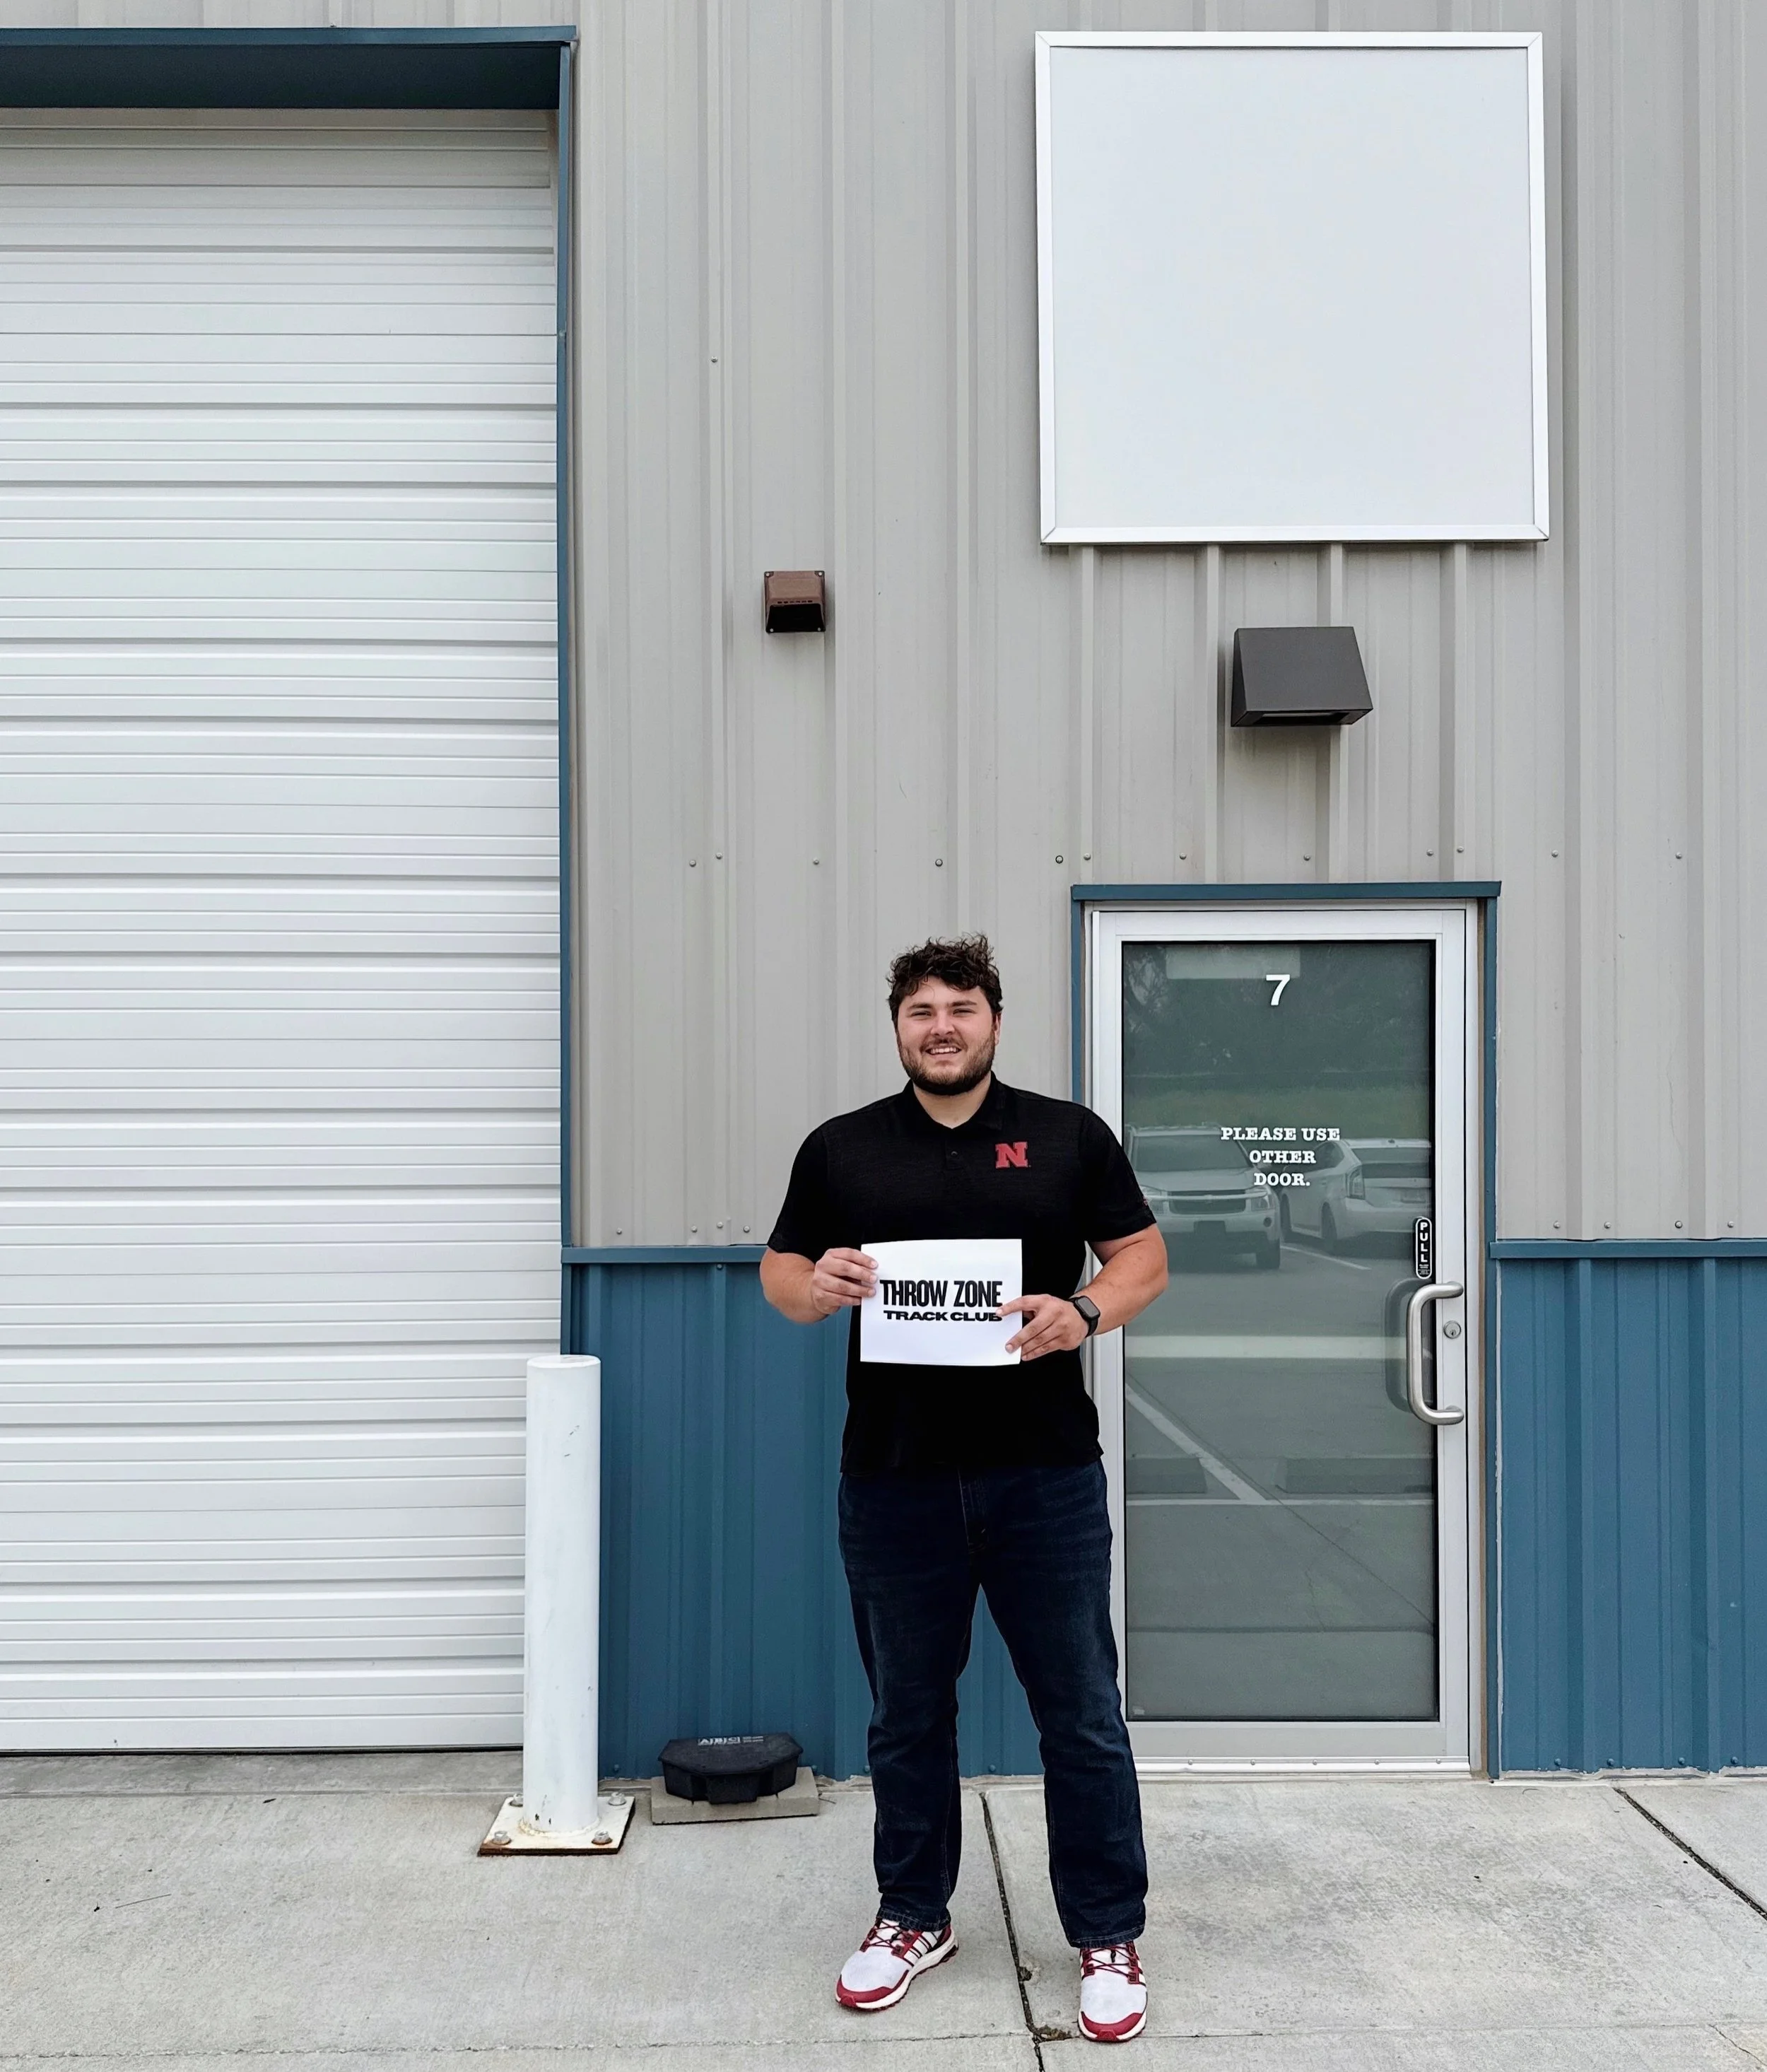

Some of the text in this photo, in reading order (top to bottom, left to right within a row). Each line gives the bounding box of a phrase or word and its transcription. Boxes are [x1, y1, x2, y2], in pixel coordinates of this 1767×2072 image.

[1266, 974, 1291, 1005] 7
[1221, 1127, 1340, 1141] PLEASE USE
[995, 1142, 1028, 1169] N
[1249, 1149, 1316, 1164] OTHER
[1254, 1173, 1310, 1186] DOOR.
[1419, 1222, 1428, 1263] PULL
[879, 1280, 1003, 1308] THROW ZONE
[884, 1310, 949, 1321] TRACK
